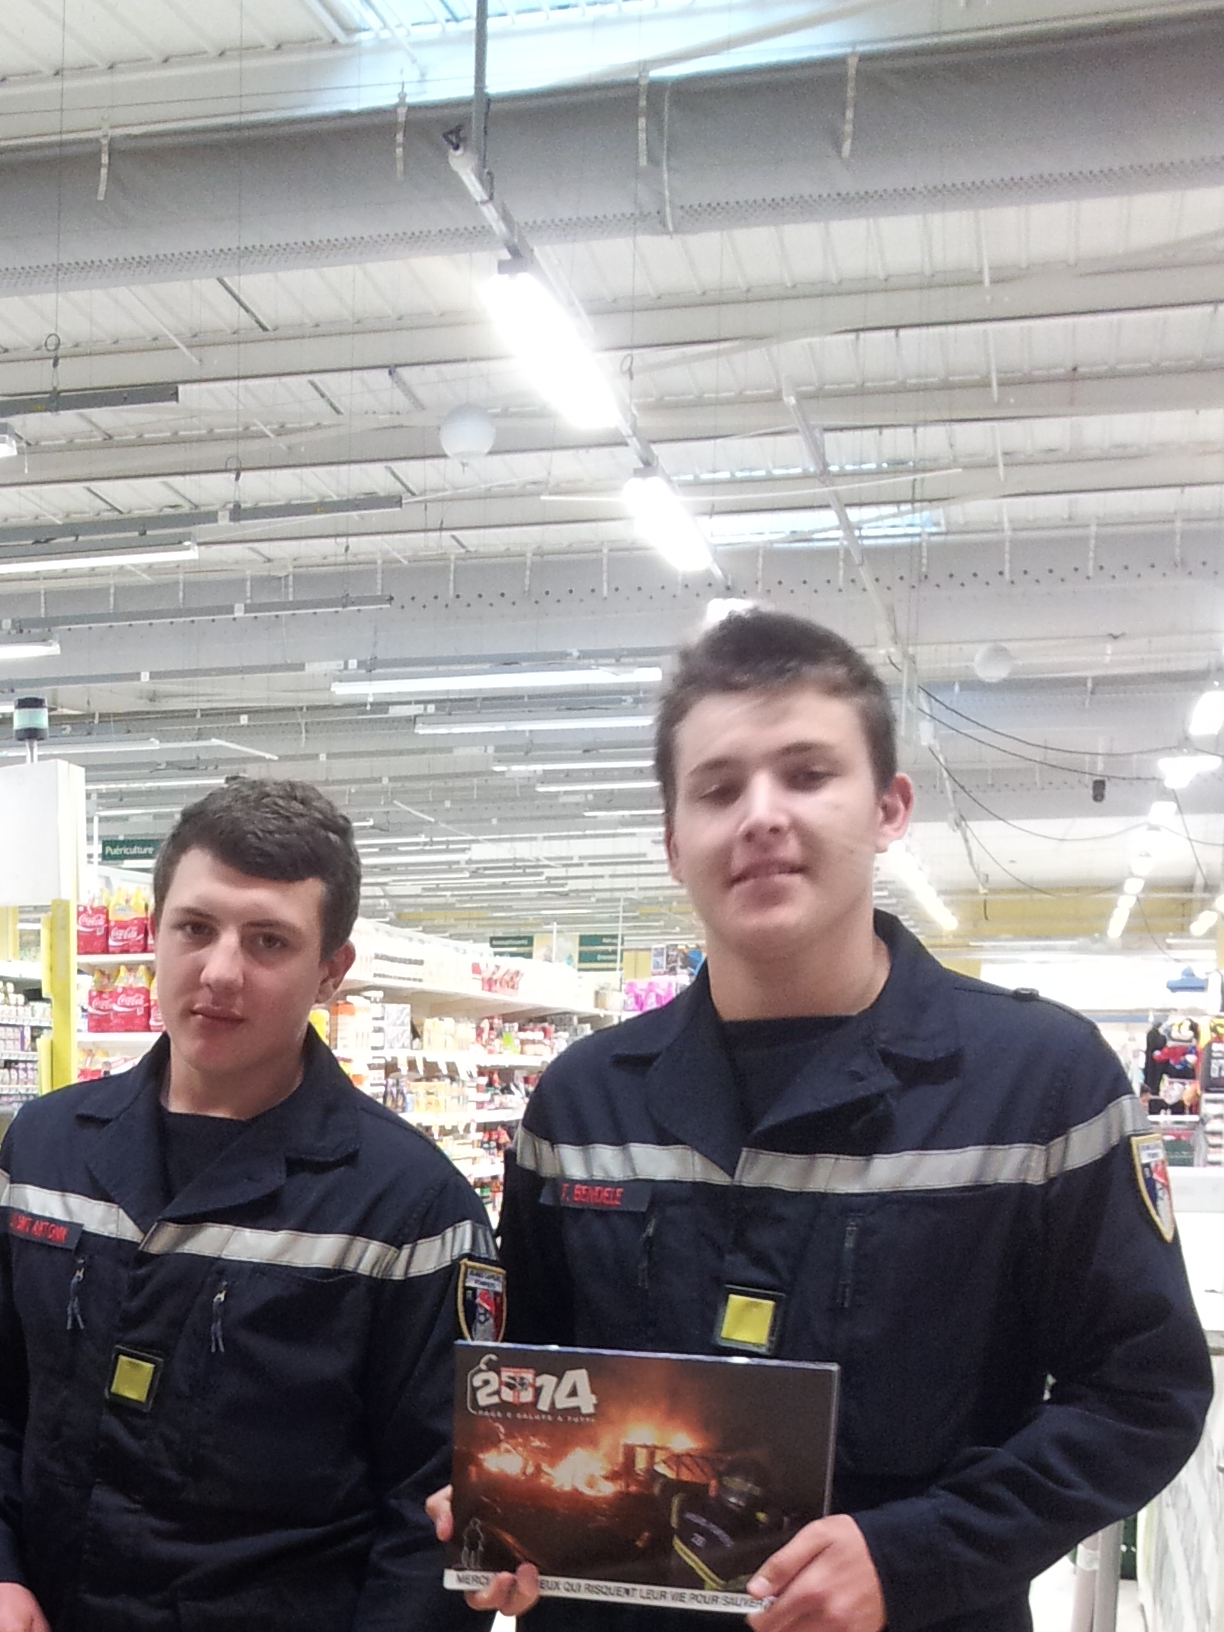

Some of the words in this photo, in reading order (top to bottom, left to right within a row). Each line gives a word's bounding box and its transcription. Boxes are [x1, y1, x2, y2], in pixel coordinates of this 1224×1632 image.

[105, 846, 154, 855] Puériculture
[540, 1580, 560, 1591] EUX
[563, 1581, 582, 1593] QUI
[584, 1584, 639, 1598] RISQUENT
[640, 1589, 667, 1600] LEUR
[670, 1592, 686, 1602] VIE
[689, 1593, 719, 1605] POUR
